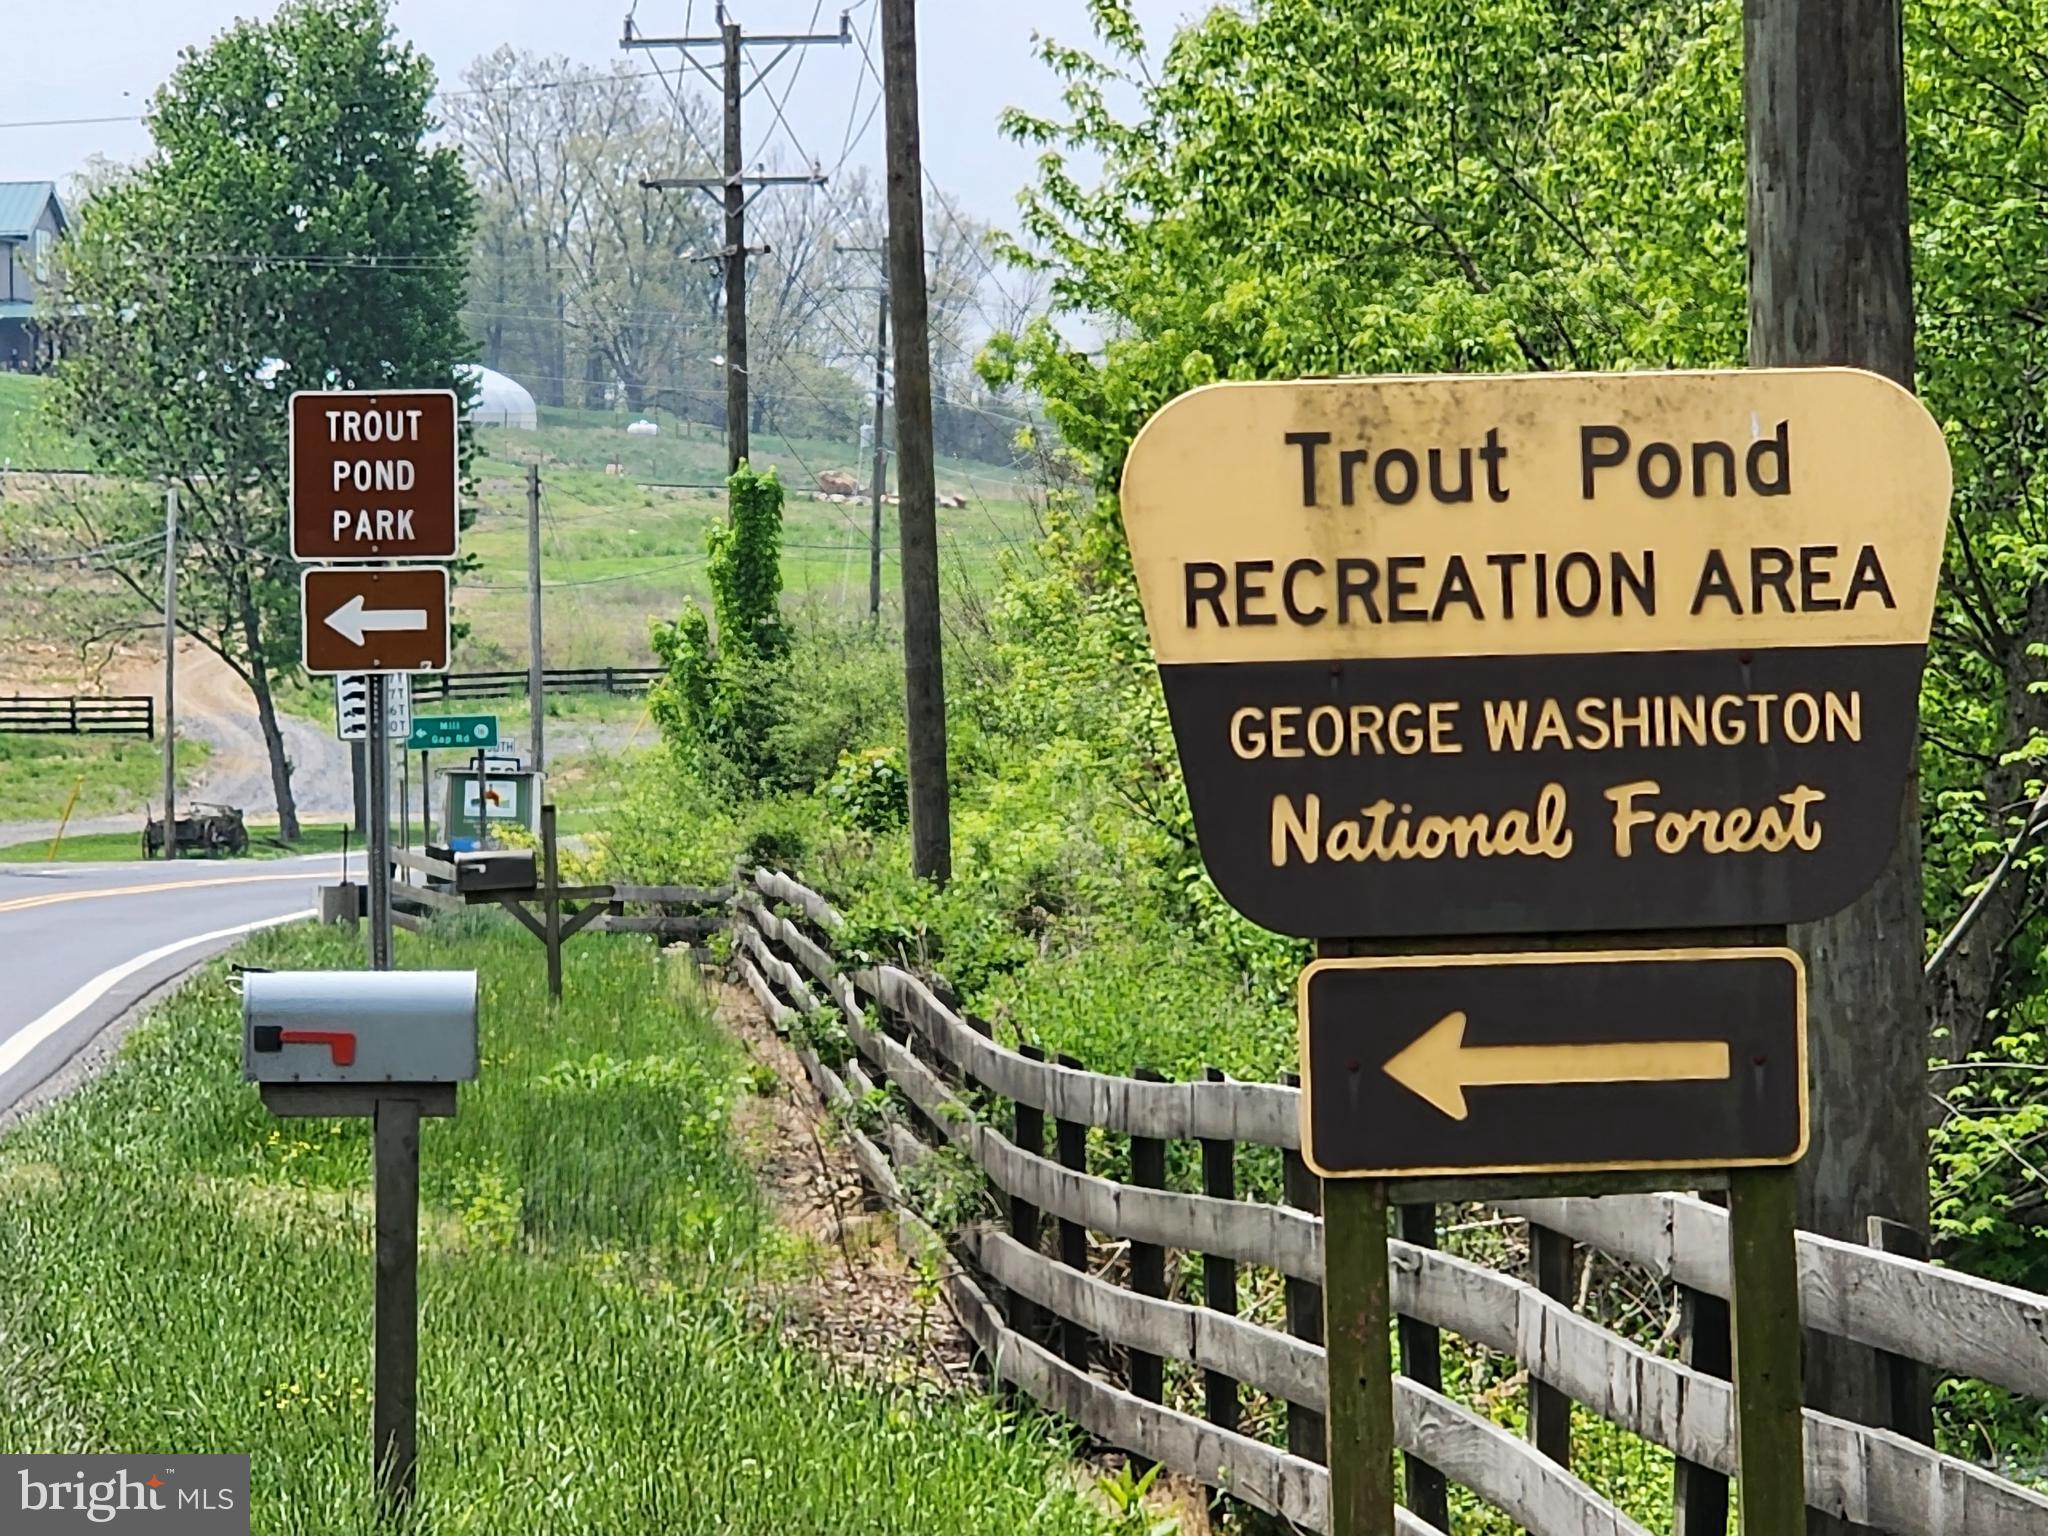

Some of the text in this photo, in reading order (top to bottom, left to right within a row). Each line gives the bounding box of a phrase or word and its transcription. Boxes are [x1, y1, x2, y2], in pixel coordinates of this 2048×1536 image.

[325, 410, 423, 442] TROUT
[333, 459, 415, 492] POND
[1284, 418, 1792, 507] Trout Pond
[333, 509, 416, 542] PARK
[1185, 544, 1898, 630] RECREATION AREA
[431, 734, 470, 745] Gap Rd
[440, 721, 461, 730] Mill
[1229, 689, 1863, 761] GEORGE WASHINGTON
[1270, 780, 1827, 868] National Forest
